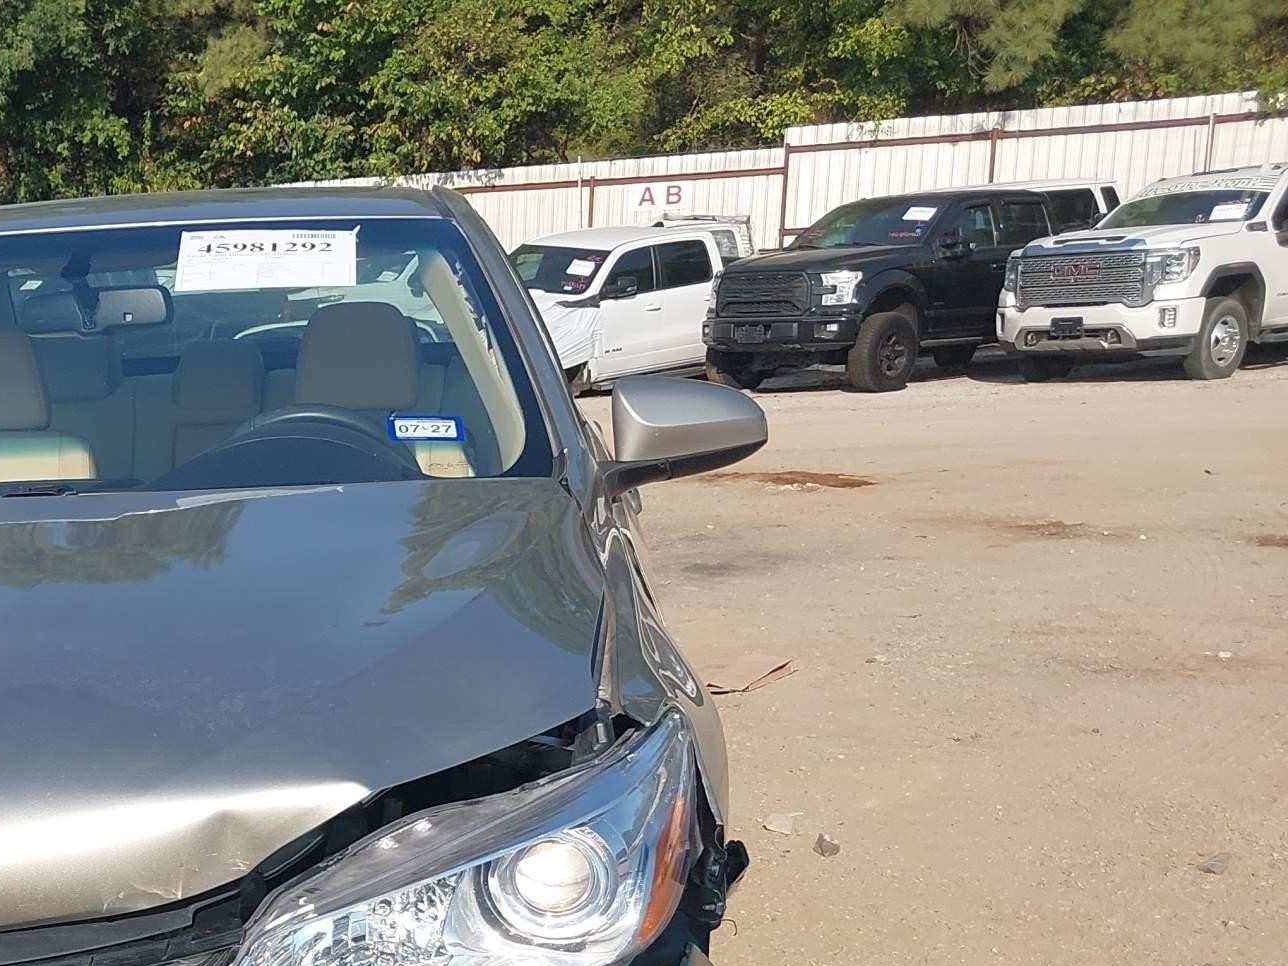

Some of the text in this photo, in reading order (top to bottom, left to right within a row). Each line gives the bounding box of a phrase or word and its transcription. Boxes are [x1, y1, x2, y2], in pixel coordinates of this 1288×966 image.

[638, 185, 682, 206] A B
[197, 241, 333, 254] 45981292
[1054, 263, 1098, 276] GMC
[398, 424, 452, 433] 07 27
